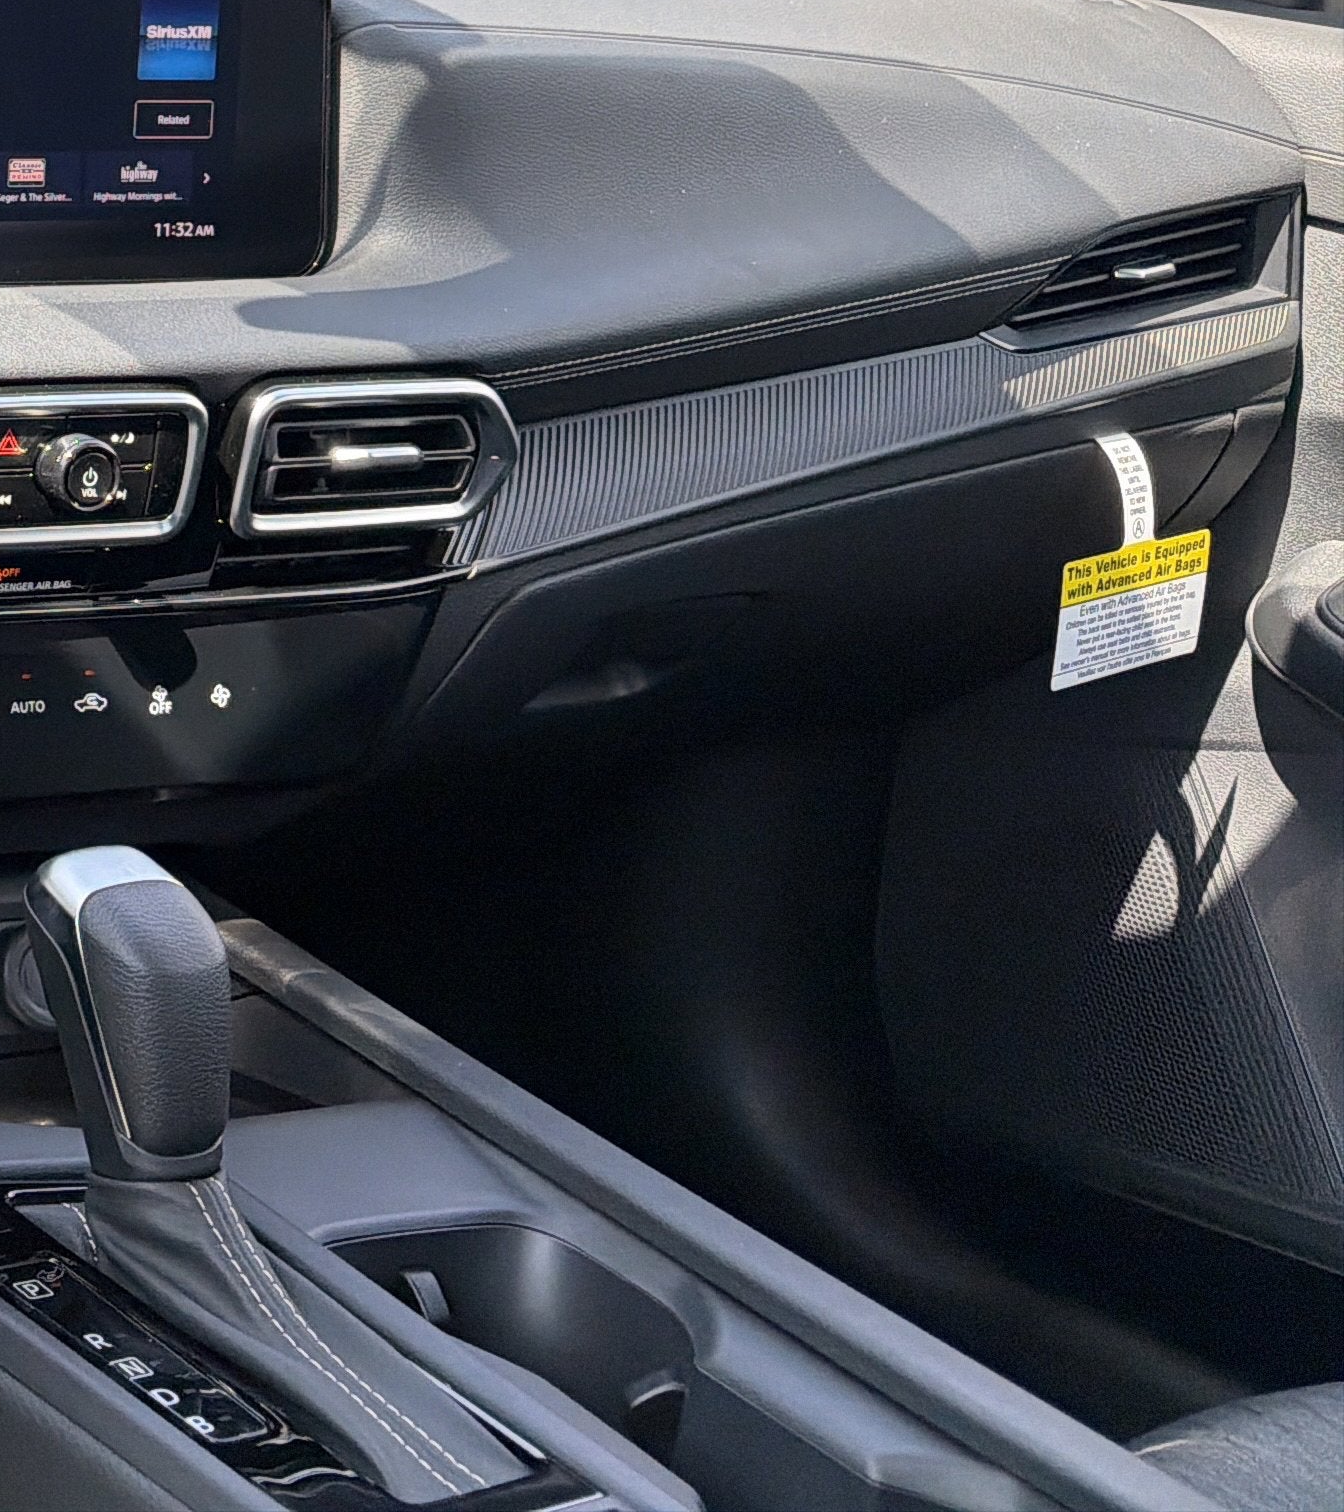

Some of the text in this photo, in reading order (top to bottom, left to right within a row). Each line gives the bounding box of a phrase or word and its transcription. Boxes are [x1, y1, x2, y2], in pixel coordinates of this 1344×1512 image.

[146, 25, 212, 39] SiriusXM
[157, 115, 190, 125] Related
[120, 166, 158, 182] highway
[20, 194, 26, 202] &
[28, 193, 42, 202] The
[93, 192, 126, 202] Highway
[128, 192, 162, 202] Mornings
[154, 222, 214, 238] 11:32 AM
[81, 487, 98, 498] VOL
[1067, 535, 1205, 581] This Vehicle is Equipped
[2, 568, 20, 577] OFF
[1067, 557, 1201, 600] with Advanced Air Bags
[35, 581, 51, 590] AIR
[53, 580, 71, 589] BAG
[10, 700, 46, 714] AUTO
[149, 701, 172, 715] OFF
[82, 1333, 113, 1350] R
[148, 1388, 180, 1407] D
[184, 1415, 215, 1435] B
